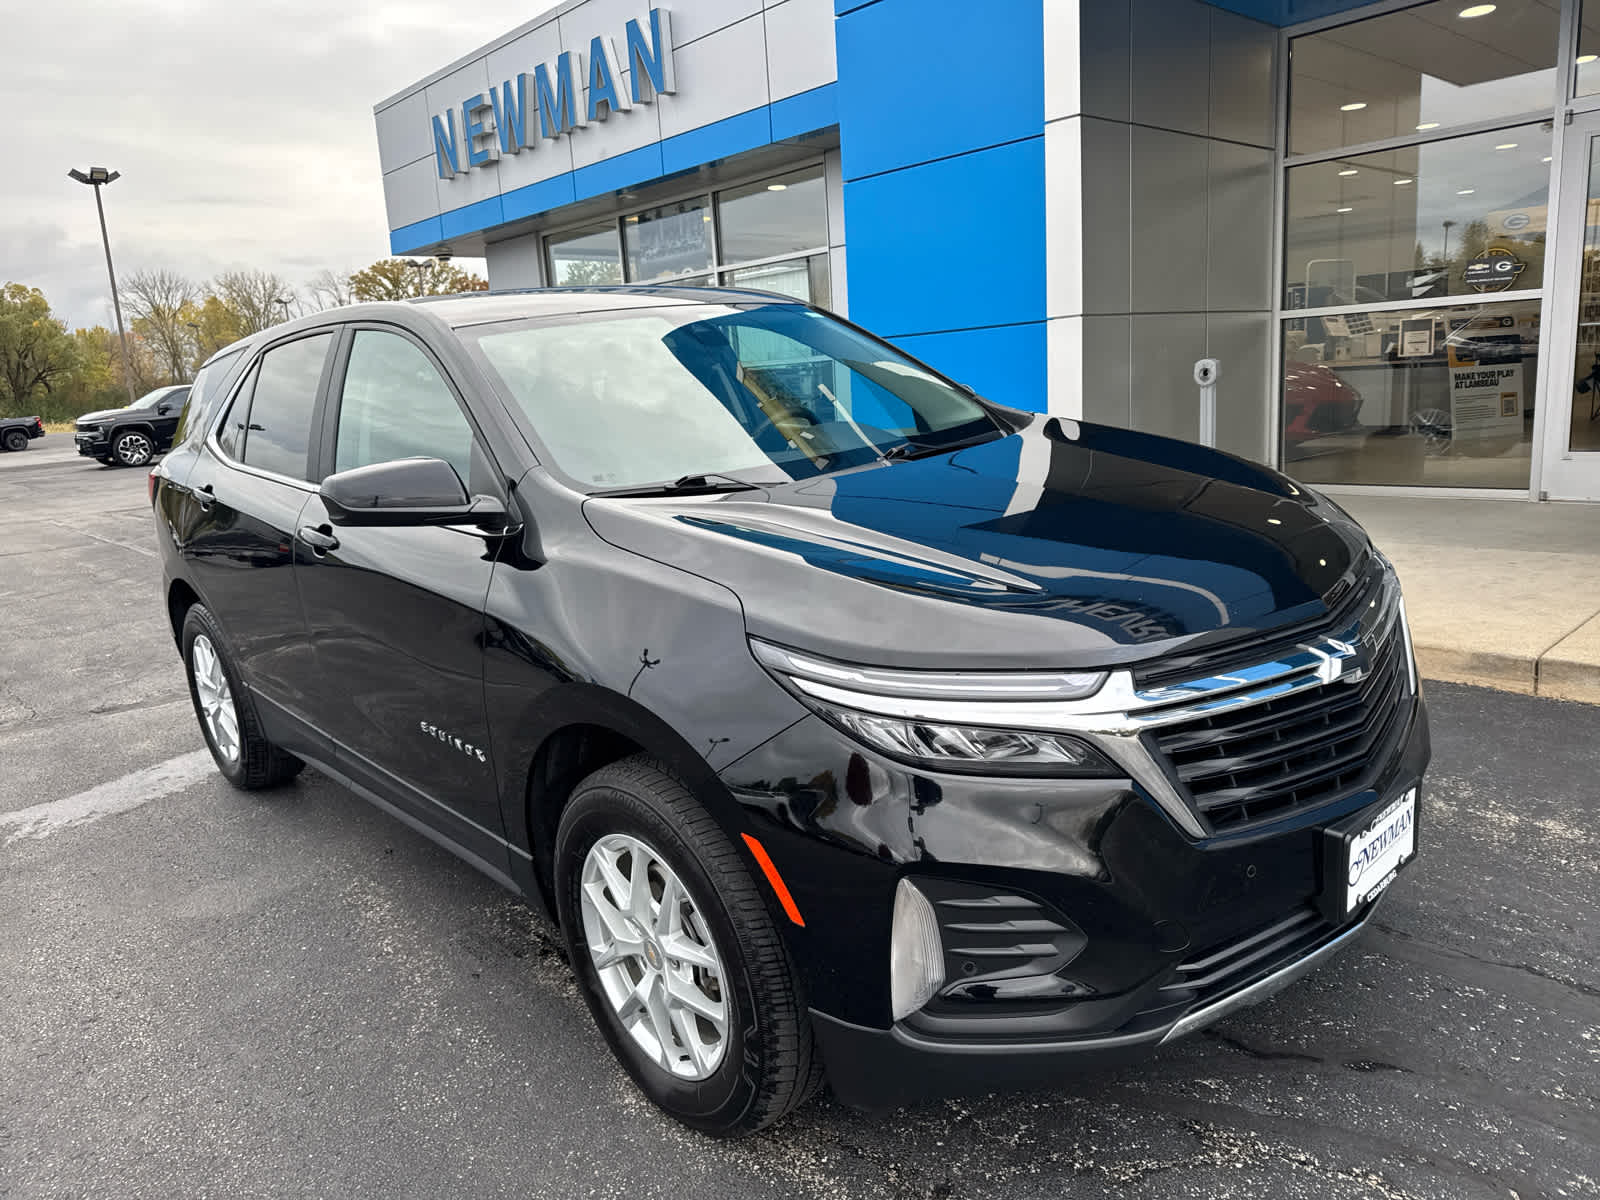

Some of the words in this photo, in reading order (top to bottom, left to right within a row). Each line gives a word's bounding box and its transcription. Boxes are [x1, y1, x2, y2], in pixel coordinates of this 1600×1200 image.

[432, 8, 675, 179] NEWMAN
[1455, 372, 1476, 380] MAKE
[1476, 370, 1497, 379] YOUR
[1497, 369, 1514, 378] PLAY
[1455, 380, 1464, 389] AT
[420, 721, 486, 762] EQUINOX
[1348, 806, 1413, 887] NEWMAN
